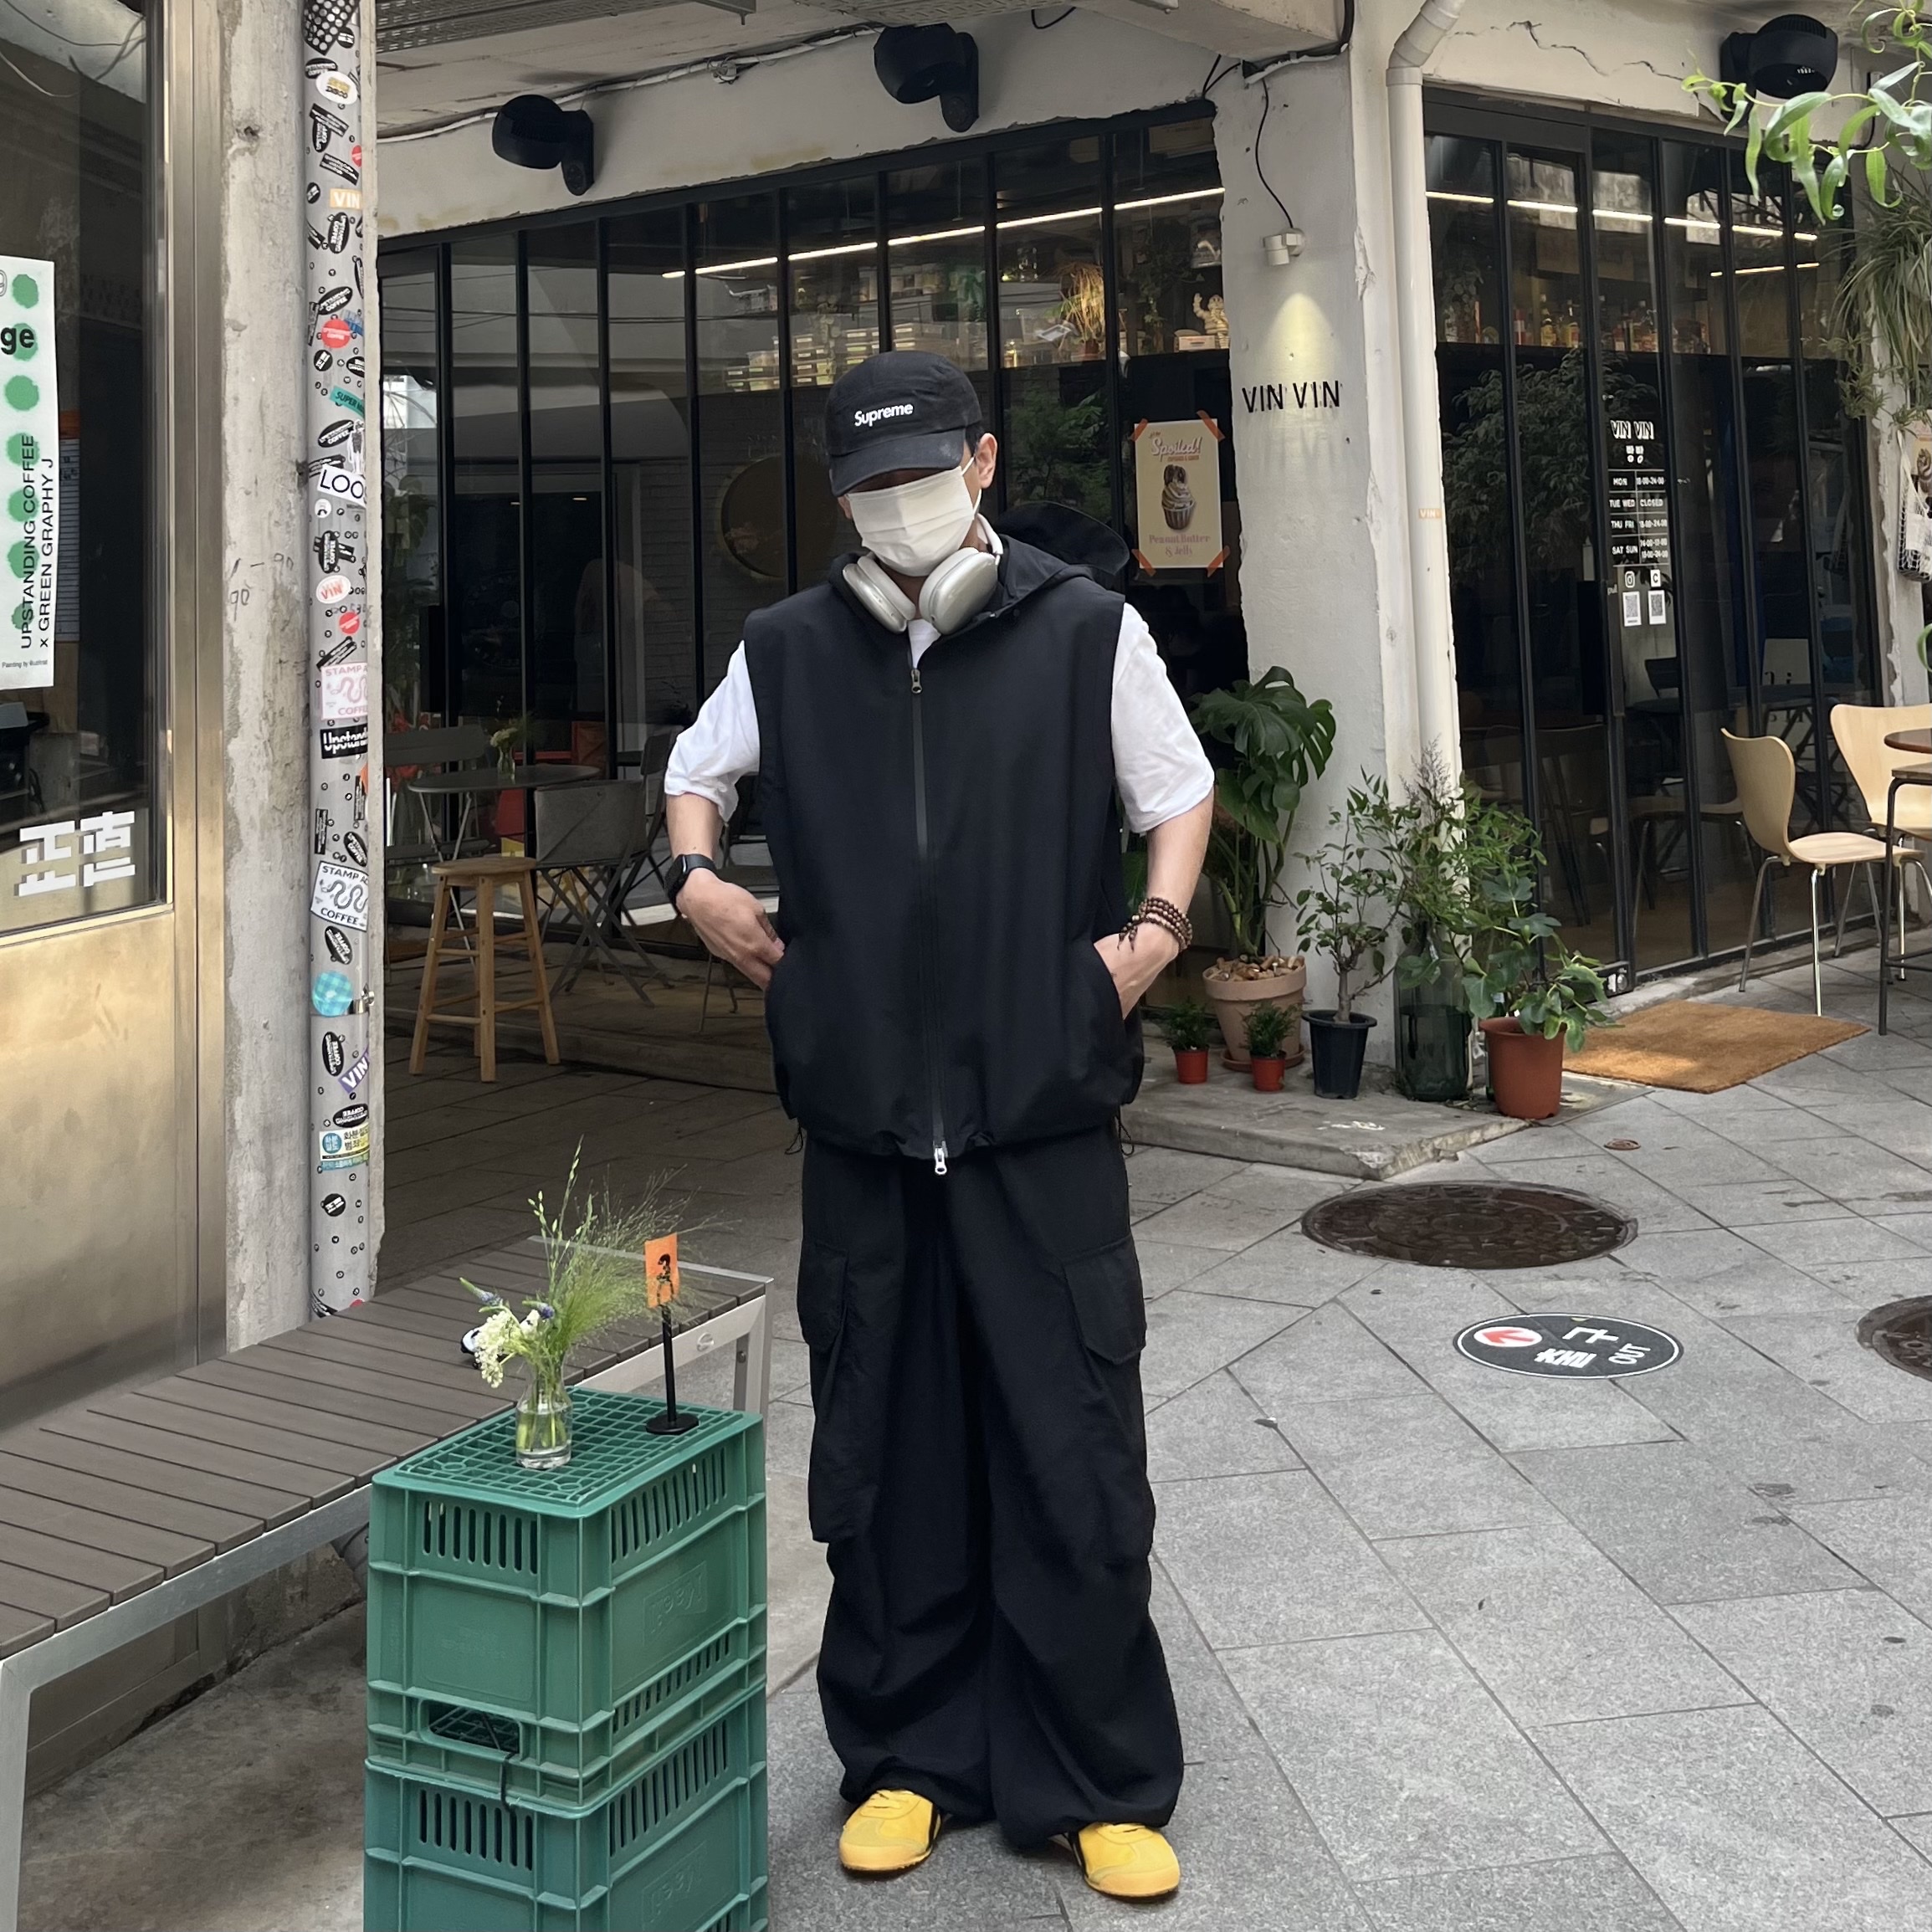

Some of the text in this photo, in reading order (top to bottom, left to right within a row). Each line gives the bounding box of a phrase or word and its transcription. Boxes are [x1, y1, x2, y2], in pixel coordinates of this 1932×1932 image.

[335, 191, 361, 208] VIN
[1, 327, 34, 355] ge
[1242, 380, 1340, 413] VIN VIN
[854, 403, 914, 427] Supreme
[1610, 420, 1654, 439] VIN VIN
[42, 459, 54, 469] J
[1612, 477, 1627, 485] MON
[1640, 498, 1663, 507] CLOSED
[42, 473, 54, 556] GRAPHY
[1611, 520, 1622, 529] THU
[1625, 520, 1635, 529] FRI
[21, 435, 35, 648] UPSTANDING COFFEE
[1149, 534, 1211, 544] Peanut Butter
[1612, 546, 1638, 555] SAT SUN
[38, 563, 53, 631] GREEN
[325, 664, 361, 676] STAMP
[322, 865, 359, 879] STAMP
[320, 907, 359, 925] COFFEE
[341, 1057, 368, 1089] VIN
[1535, 1327, 1619, 1368] 출구
[1608, 1343, 1651, 1365] OUT
